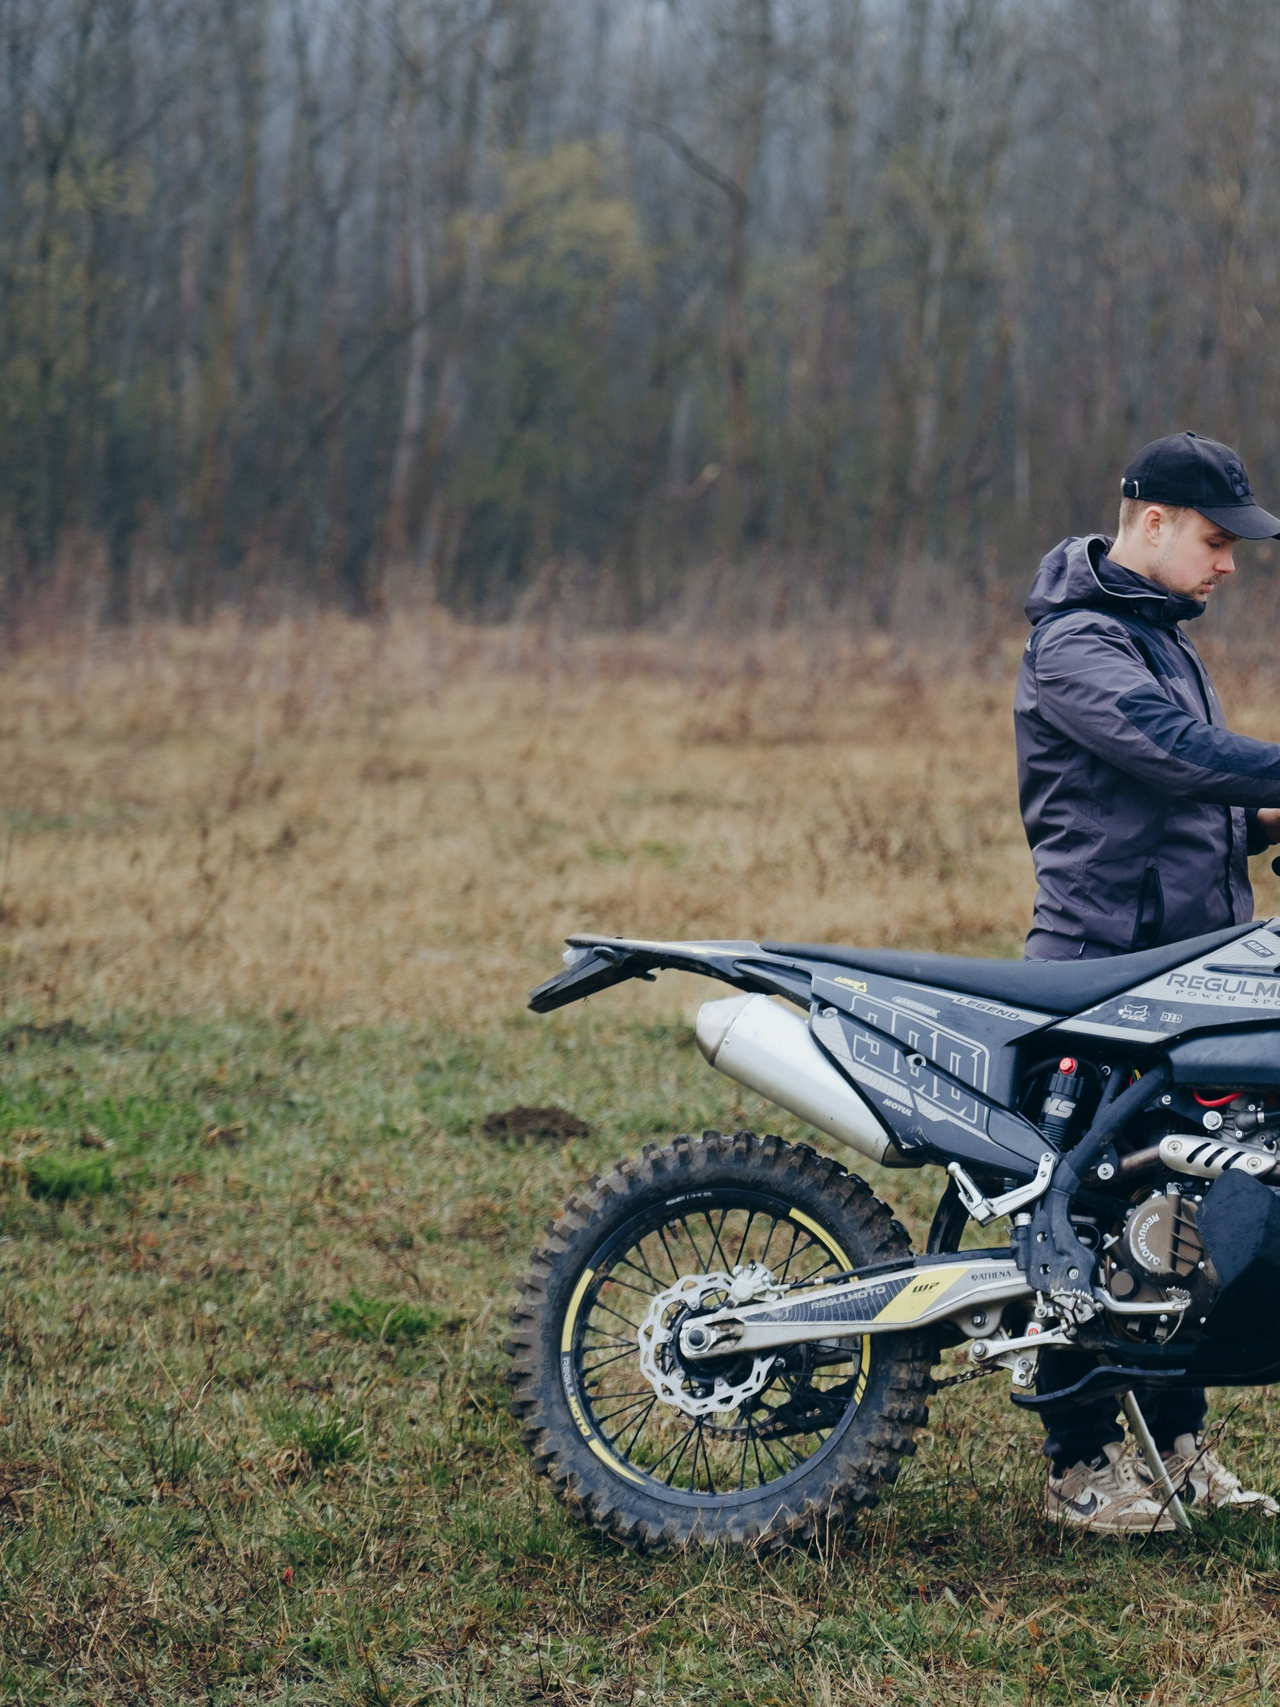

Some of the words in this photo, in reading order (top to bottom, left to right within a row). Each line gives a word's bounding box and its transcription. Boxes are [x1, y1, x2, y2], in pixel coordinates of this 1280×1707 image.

[1175, 989, 1237, 1002] POWER
[956, 997, 1020, 1020] LEGEND
[1161, 1012, 1182, 1023] DID
[882, 1098, 912, 1117] MOTUL
[1138, 1213, 1160, 1266] REGULMOTO
[978, 1270, 1012, 1281] ATHENA
[810, 1285, 887, 1311] REGULMOTO
[561, 1356, 592, 1437] REGULMOTO
